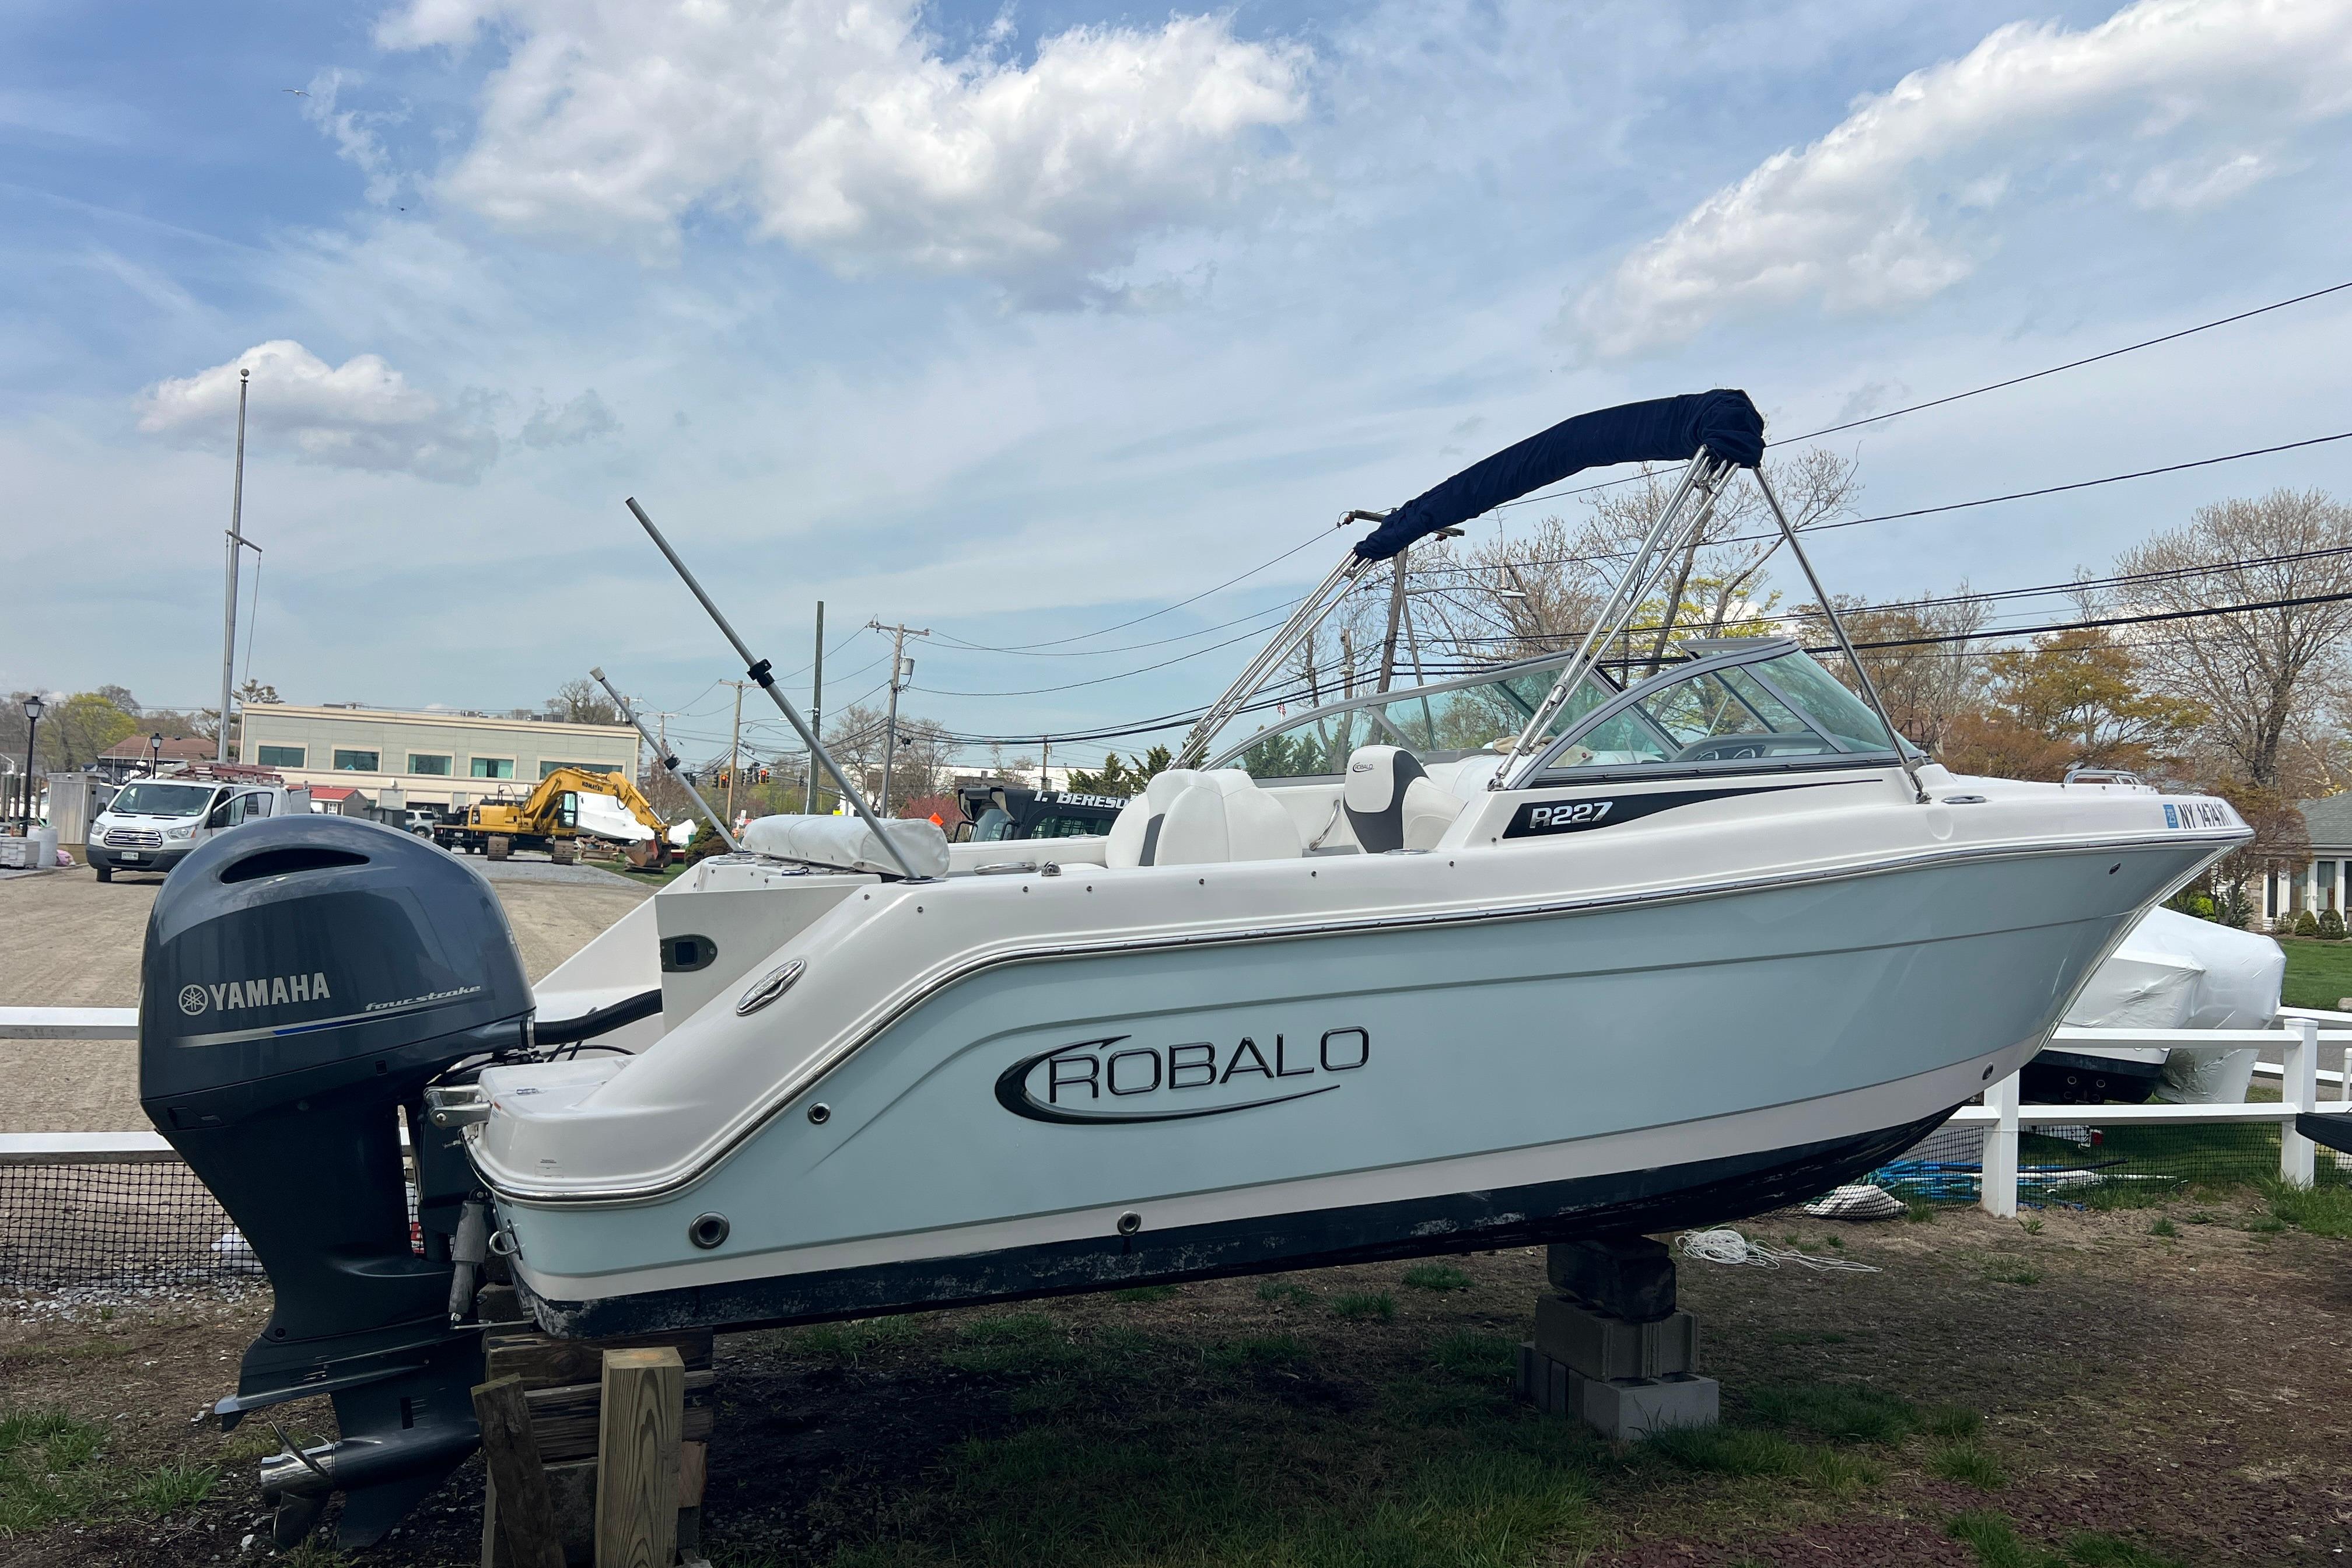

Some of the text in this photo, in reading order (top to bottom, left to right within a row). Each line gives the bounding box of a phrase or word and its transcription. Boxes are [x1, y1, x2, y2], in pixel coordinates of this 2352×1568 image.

[582, 781, 603, 792] KOMATSU
[1529, 801, 1613, 829] R227
[2178, 804, 2196, 829] NY
[209, 972, 330, 1011] YAMAHA
[1049, 1026, 1369, 1103] ROBALO
